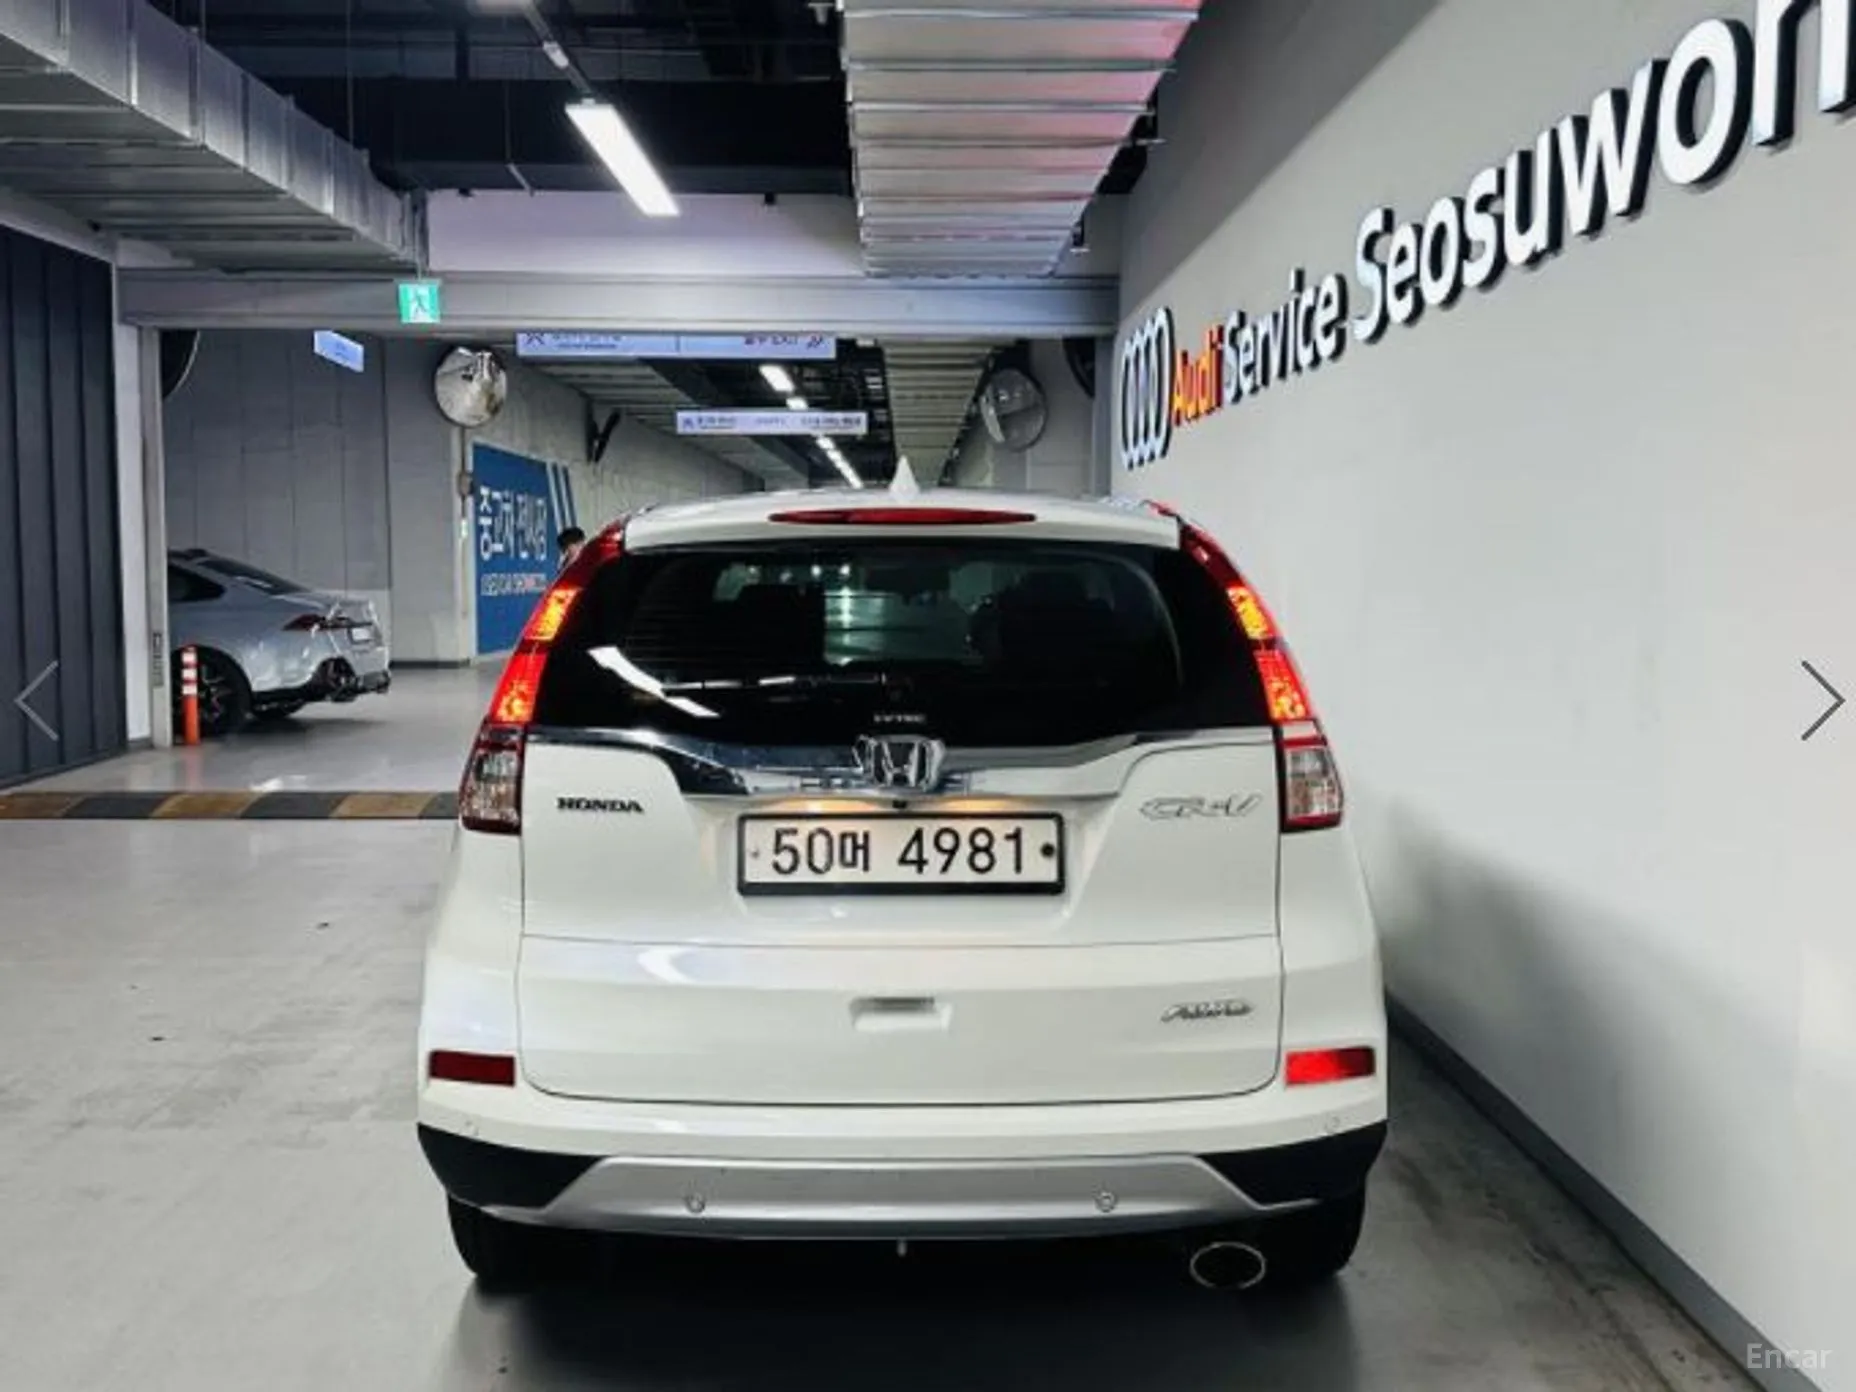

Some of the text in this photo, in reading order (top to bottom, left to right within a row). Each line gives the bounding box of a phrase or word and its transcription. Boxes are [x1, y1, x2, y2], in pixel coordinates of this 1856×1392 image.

[1172, 0, 1856, 426] Audi Service Seosuwon
[556, 797, 645, 814] HONDA
[1139, 794, 1262, 820] CR-V
[771, 827, 1024, 875] 50머 4981
